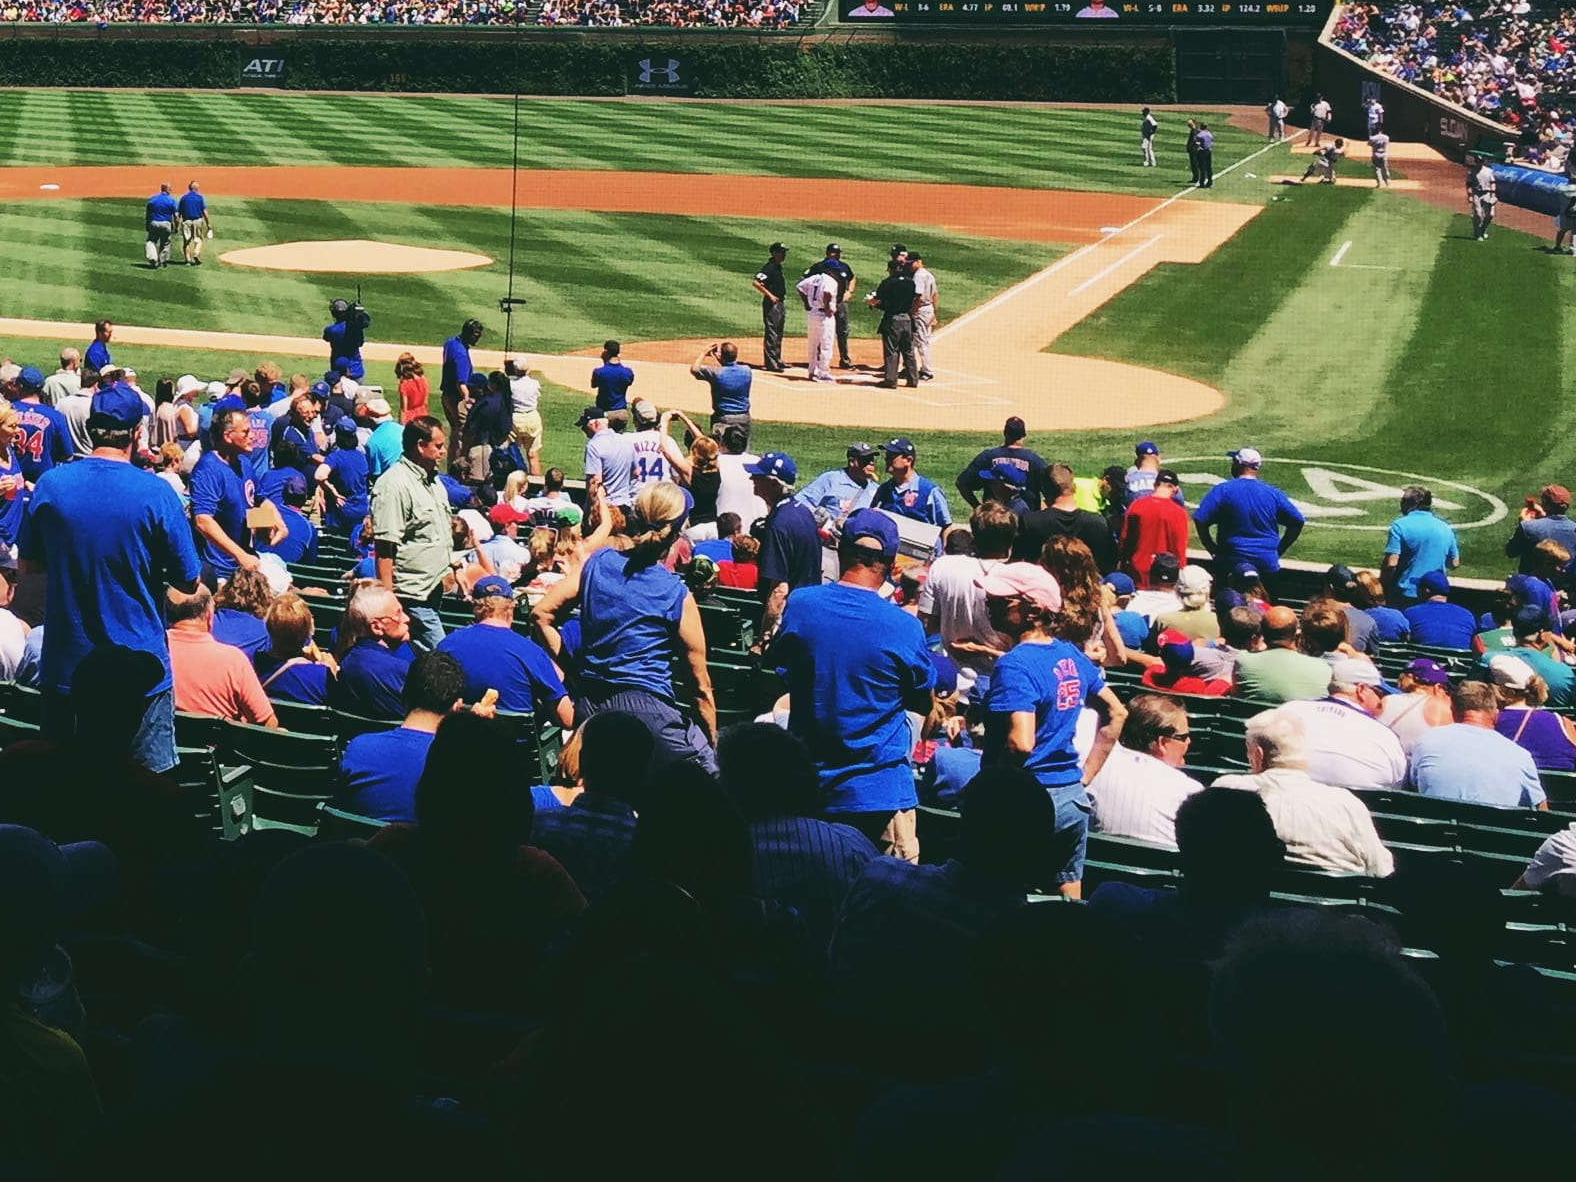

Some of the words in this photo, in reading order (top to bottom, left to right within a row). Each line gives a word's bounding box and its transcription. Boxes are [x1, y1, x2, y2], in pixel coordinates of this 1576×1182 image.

[243, 58, 285, 72] ATI
[633, 440, 661, 454] RIZZ
[638, 457, 664, 483] 14
[1056, 679, 1081, 711] 25
